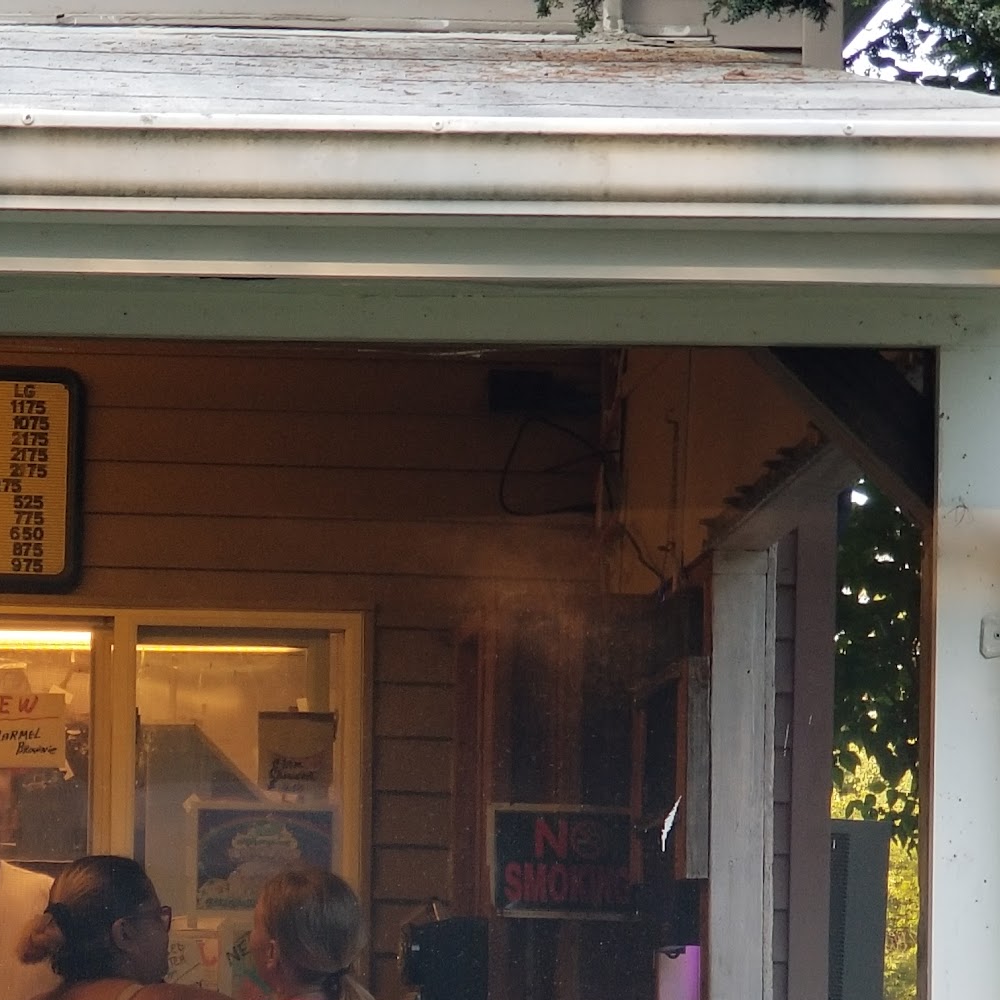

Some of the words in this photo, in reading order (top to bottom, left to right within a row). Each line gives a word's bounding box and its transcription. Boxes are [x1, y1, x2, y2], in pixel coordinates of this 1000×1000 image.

[13, 384, 37, 398] LG
[10, 400, 48, 414] 1175
[12, 416, 50, 431] 1075
[11, 431, 49, 446] 2175
[10, 447, 48, 462] 2175
[13, 496, 45, 510] 525
[13, 510, 45, 526] 775
[9, 526, 45, 541] 650
[11, 542, 45, 557] 875
[10, 558, 44, 573] 975
